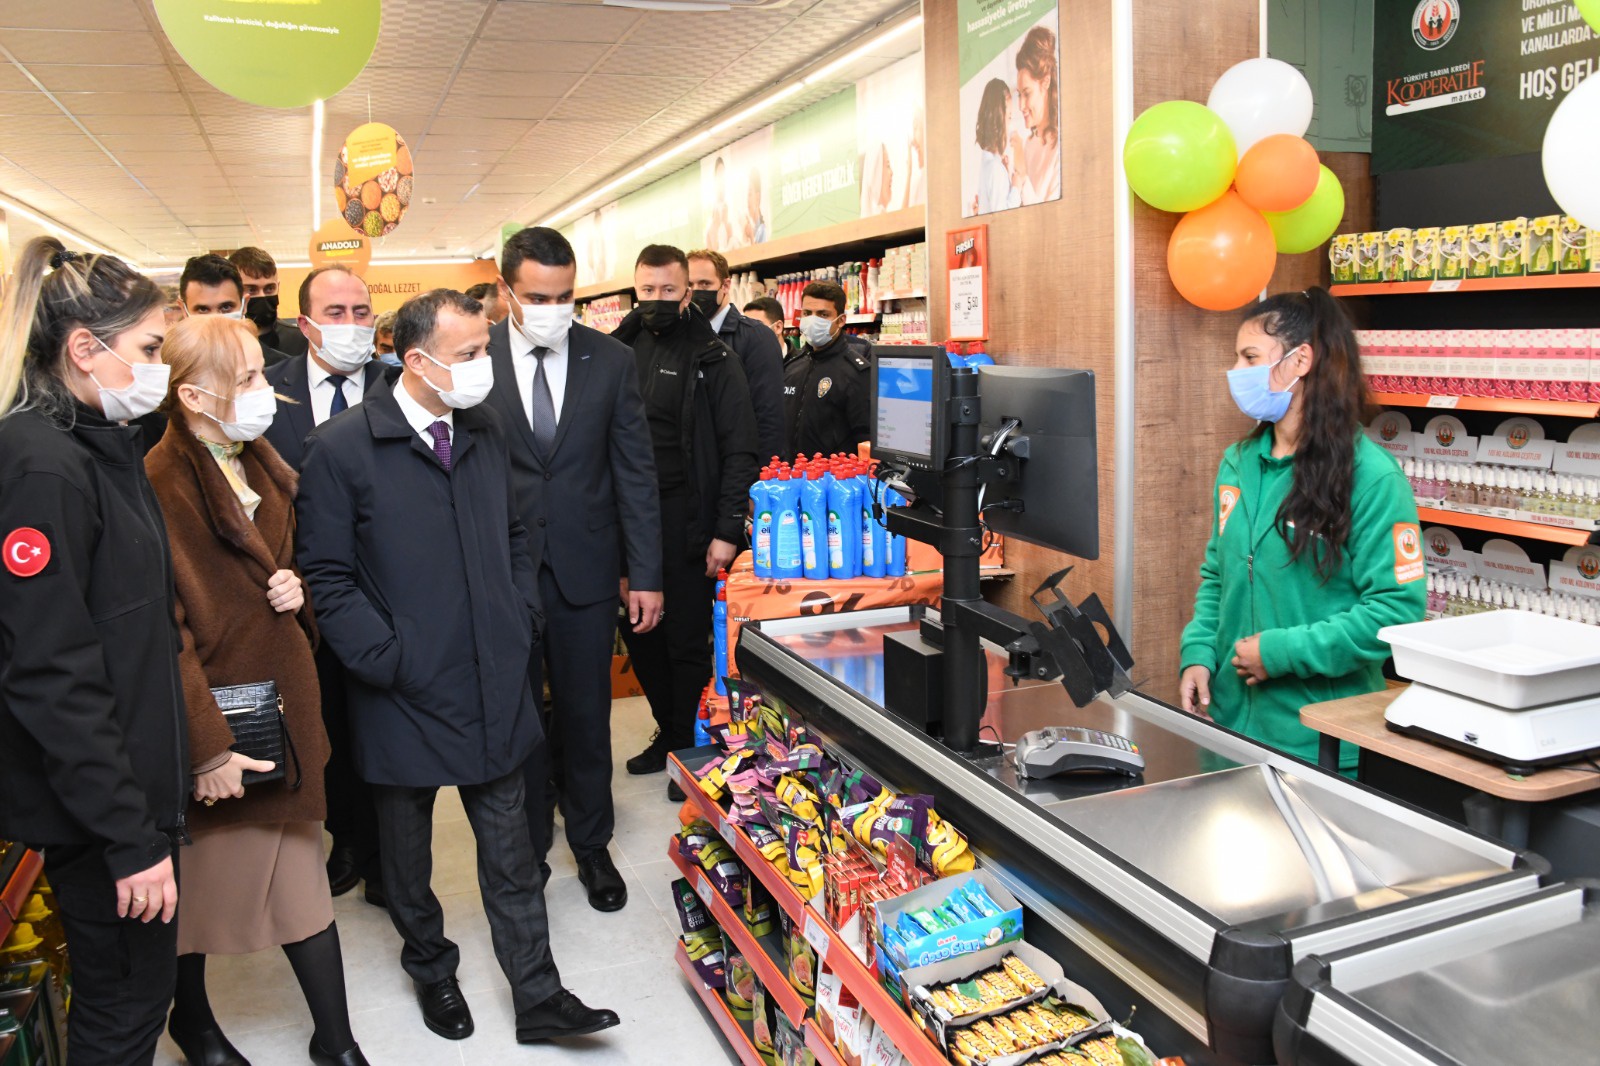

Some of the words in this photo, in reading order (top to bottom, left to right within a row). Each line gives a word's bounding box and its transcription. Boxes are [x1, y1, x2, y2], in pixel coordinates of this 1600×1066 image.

[1521, 16, 1535, 33] VE
[1520, 25, 1591, 56] KANALLARDA
[1403, 72, 1428, 83] TÜRKİYE
[1429, 67, 1450, 78] TARIM
[1450, 61, 1471, 73] KREDİ
[1520, 66, 1557, 100] HOŞ
[1451, 90, 1482, 103] market
[320, 240, 360, 251] ANADOLU
[955, 237, 975, 255] FIRSAT
[368, 283, 392, 295] DOĞAL
[394, 282, 421, 294] LEZZET
[920, 950, 950, 967] Coco
[951, 940, 980, 955] Star
